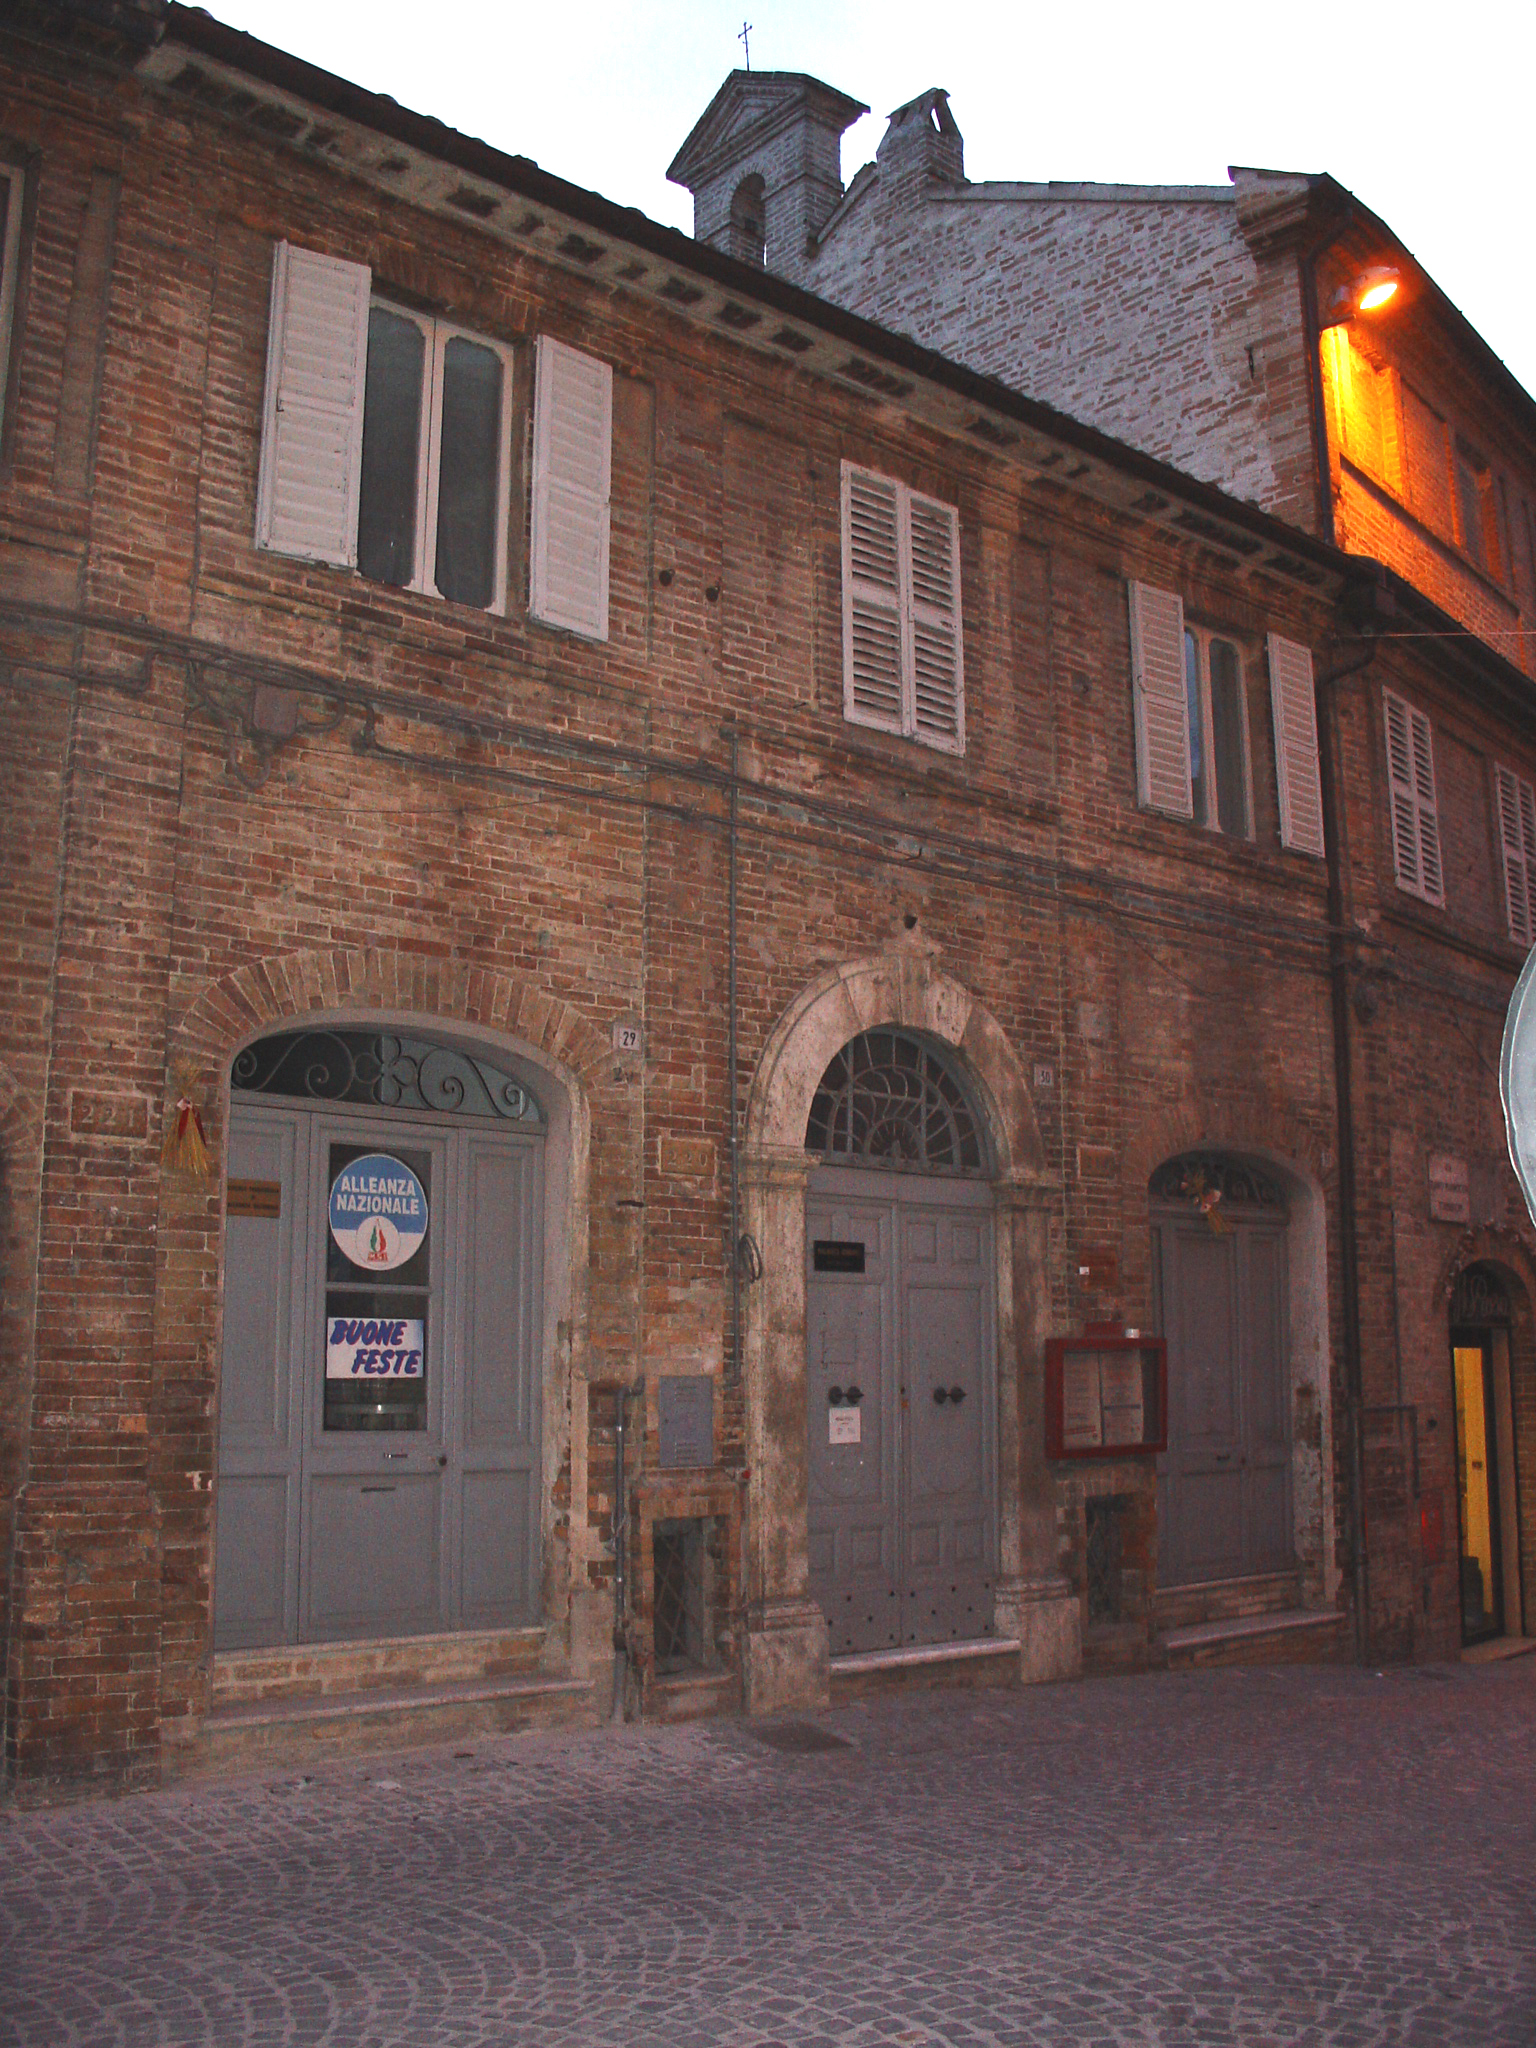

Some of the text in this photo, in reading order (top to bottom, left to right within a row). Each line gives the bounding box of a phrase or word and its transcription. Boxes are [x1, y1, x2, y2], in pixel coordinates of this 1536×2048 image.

[623, 1031, 636, 1046] 29
[81, 1104, 135, 1128] 221
[341, 1175, 416, 1197] ALLEANZA
[336, 1194, 420, 1216] NAZIONALE
[330, 1319, 408, 1346] BUONE
[351, 1348, 422, 1375] FESTE
